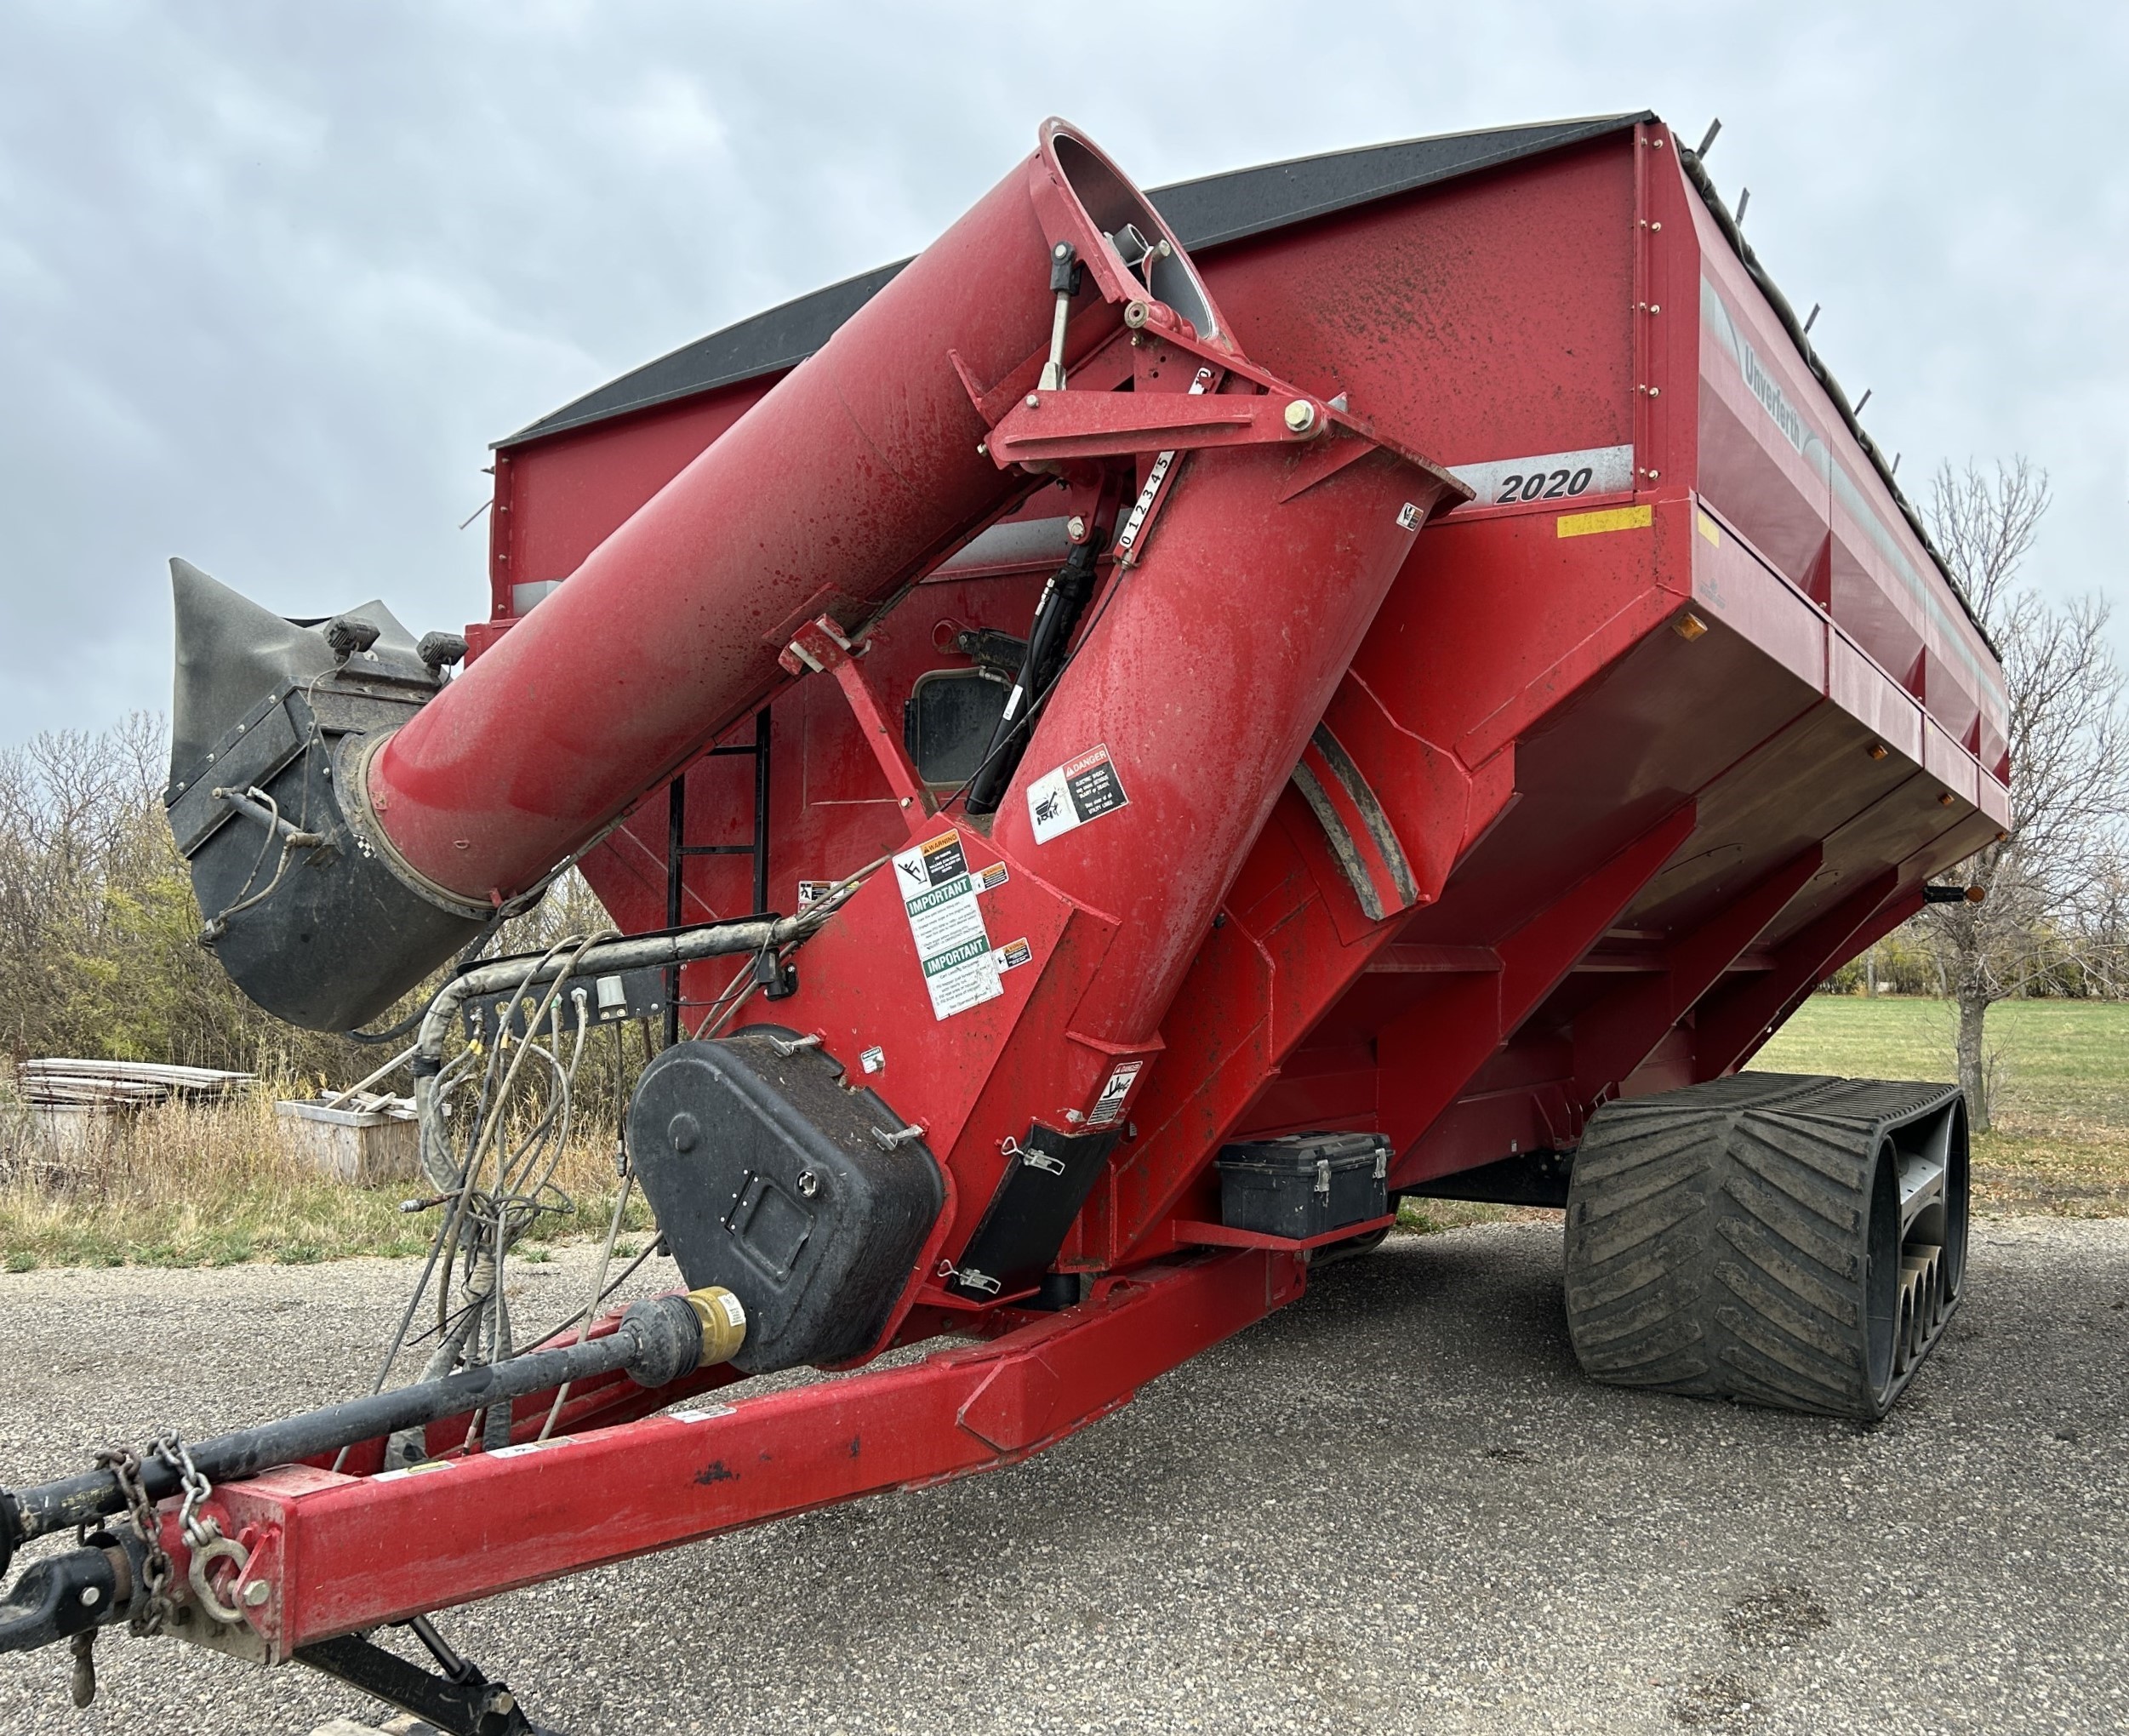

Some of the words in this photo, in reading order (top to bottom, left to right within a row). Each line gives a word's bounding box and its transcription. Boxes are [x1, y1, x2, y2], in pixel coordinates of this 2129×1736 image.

[1745, 345, 1801, 450] Unverferth
[1122, 536, 1131, 545] 0
[1129, 522, 1139, 530] 1
[1136, 505, 1146, 515] 2
[1143, 489, 1153, 500] 3
[1151, 474, 1161, 483] 4
[1158, 458, 1168, 468] 5
[1495, 468, 1593, 504] 2020
[1073, 750, 1107, 772] DANGER
[929, 835, 957, 850] WARNING
[909, 878, 968, 915] IMPORTANT
[927, 939, 983, 974] IMPORTANT
